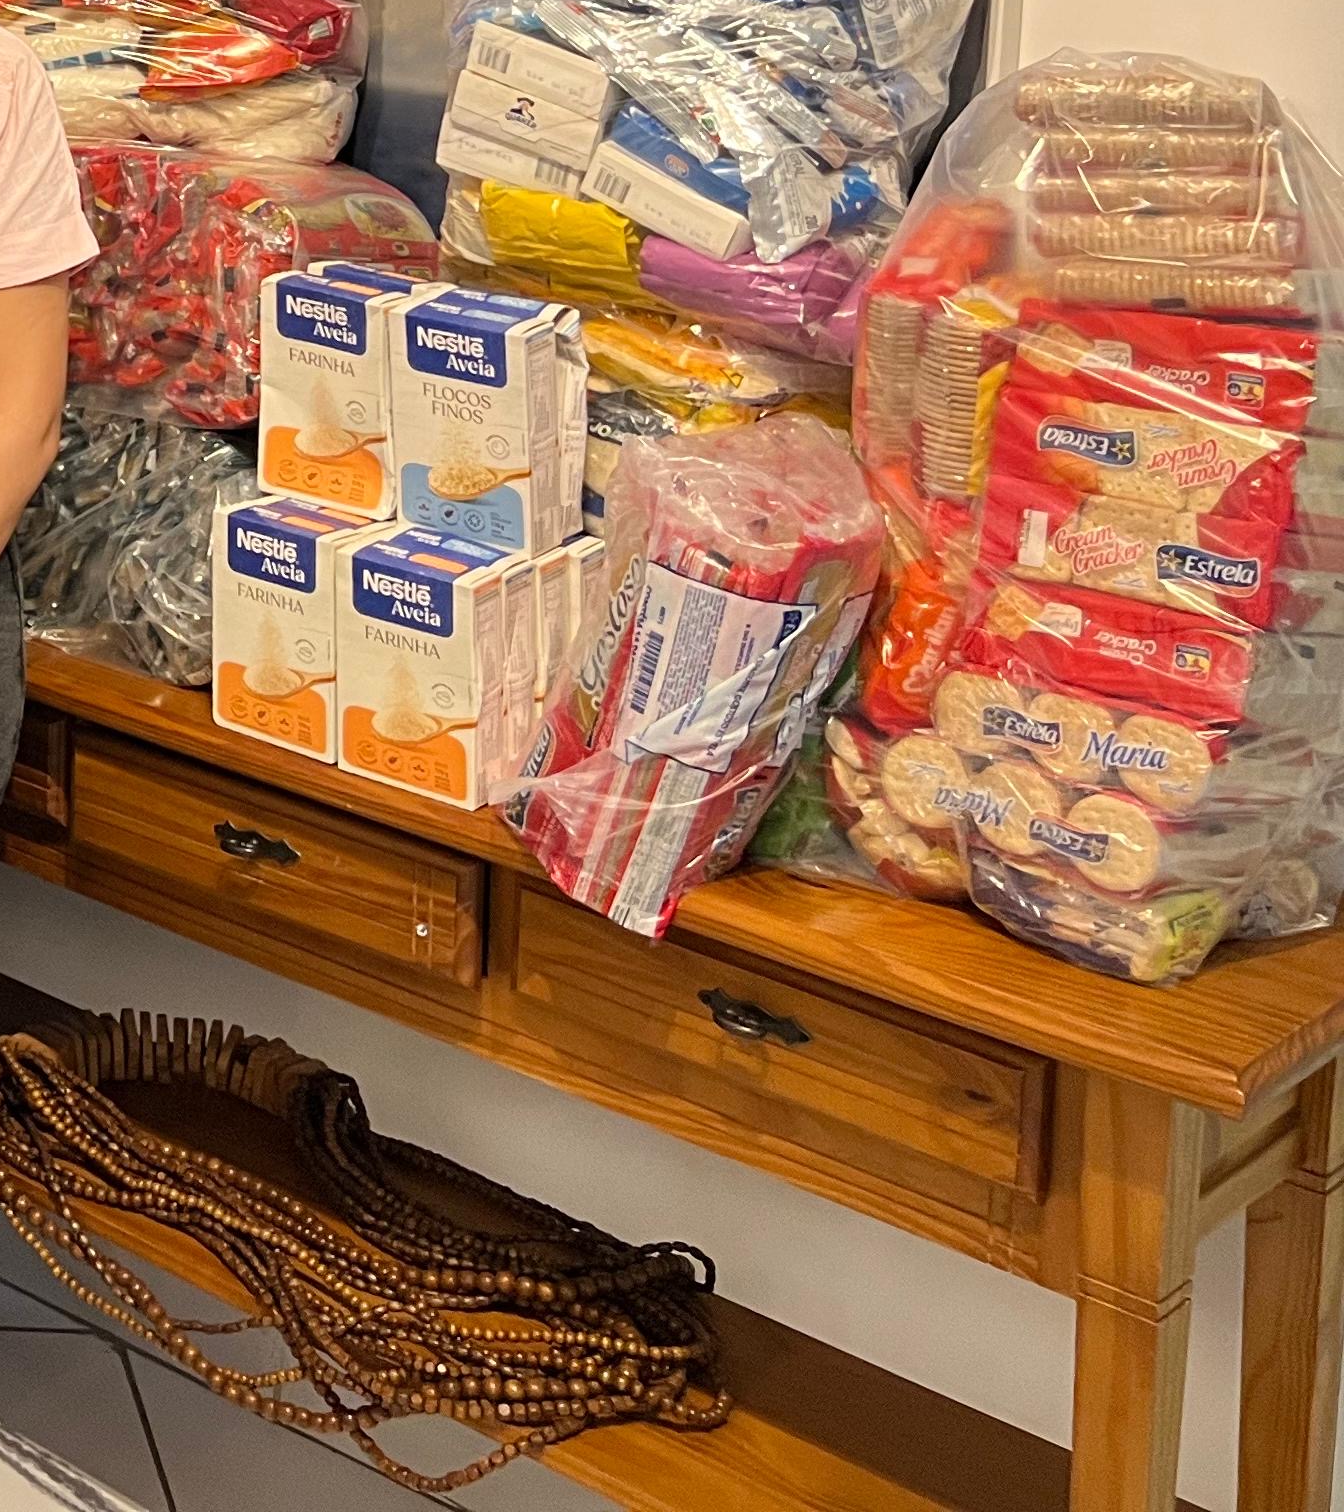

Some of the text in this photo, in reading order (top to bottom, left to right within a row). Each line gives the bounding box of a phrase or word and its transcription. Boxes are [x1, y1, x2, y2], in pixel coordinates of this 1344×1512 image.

[285, 294, 348, 326] Nestlé
[313, 322, 357, 346] Aveia
[417, 325, 485, 359] Nestlé
[288, 346, 356, 378] FARINHA
[446, 353, 496, 379] Aveia
[422, 381, 492, 410] FLOCOS
[431, 400, 484, 425] FINOS
[1043, 424, 1111, 456] Estrela
[1147, 439, 1218, 473] Cracker
[1175, 461, 1239, 488] Cream
[235, 526, 298, 563] Nestlé
[1053, 525, 1116, 556] Cream
[260, 556, 305, 583] Aveia
[1074, 539, 1144, 575] Cracker
[1183, 555, 1257, 586] Estrela
[237, 582, 304, 616] FARINHA
[362, 568, 431, 605] Nestlé
[391, 599, 442, 628] Aveia
[364, 624, 441, 660] FARINHA
[1093, 631, 1158, 655] Cracker
[1003, 715, 1058, 745] Estrela
[1081, 731, 1168, 771] Maria
